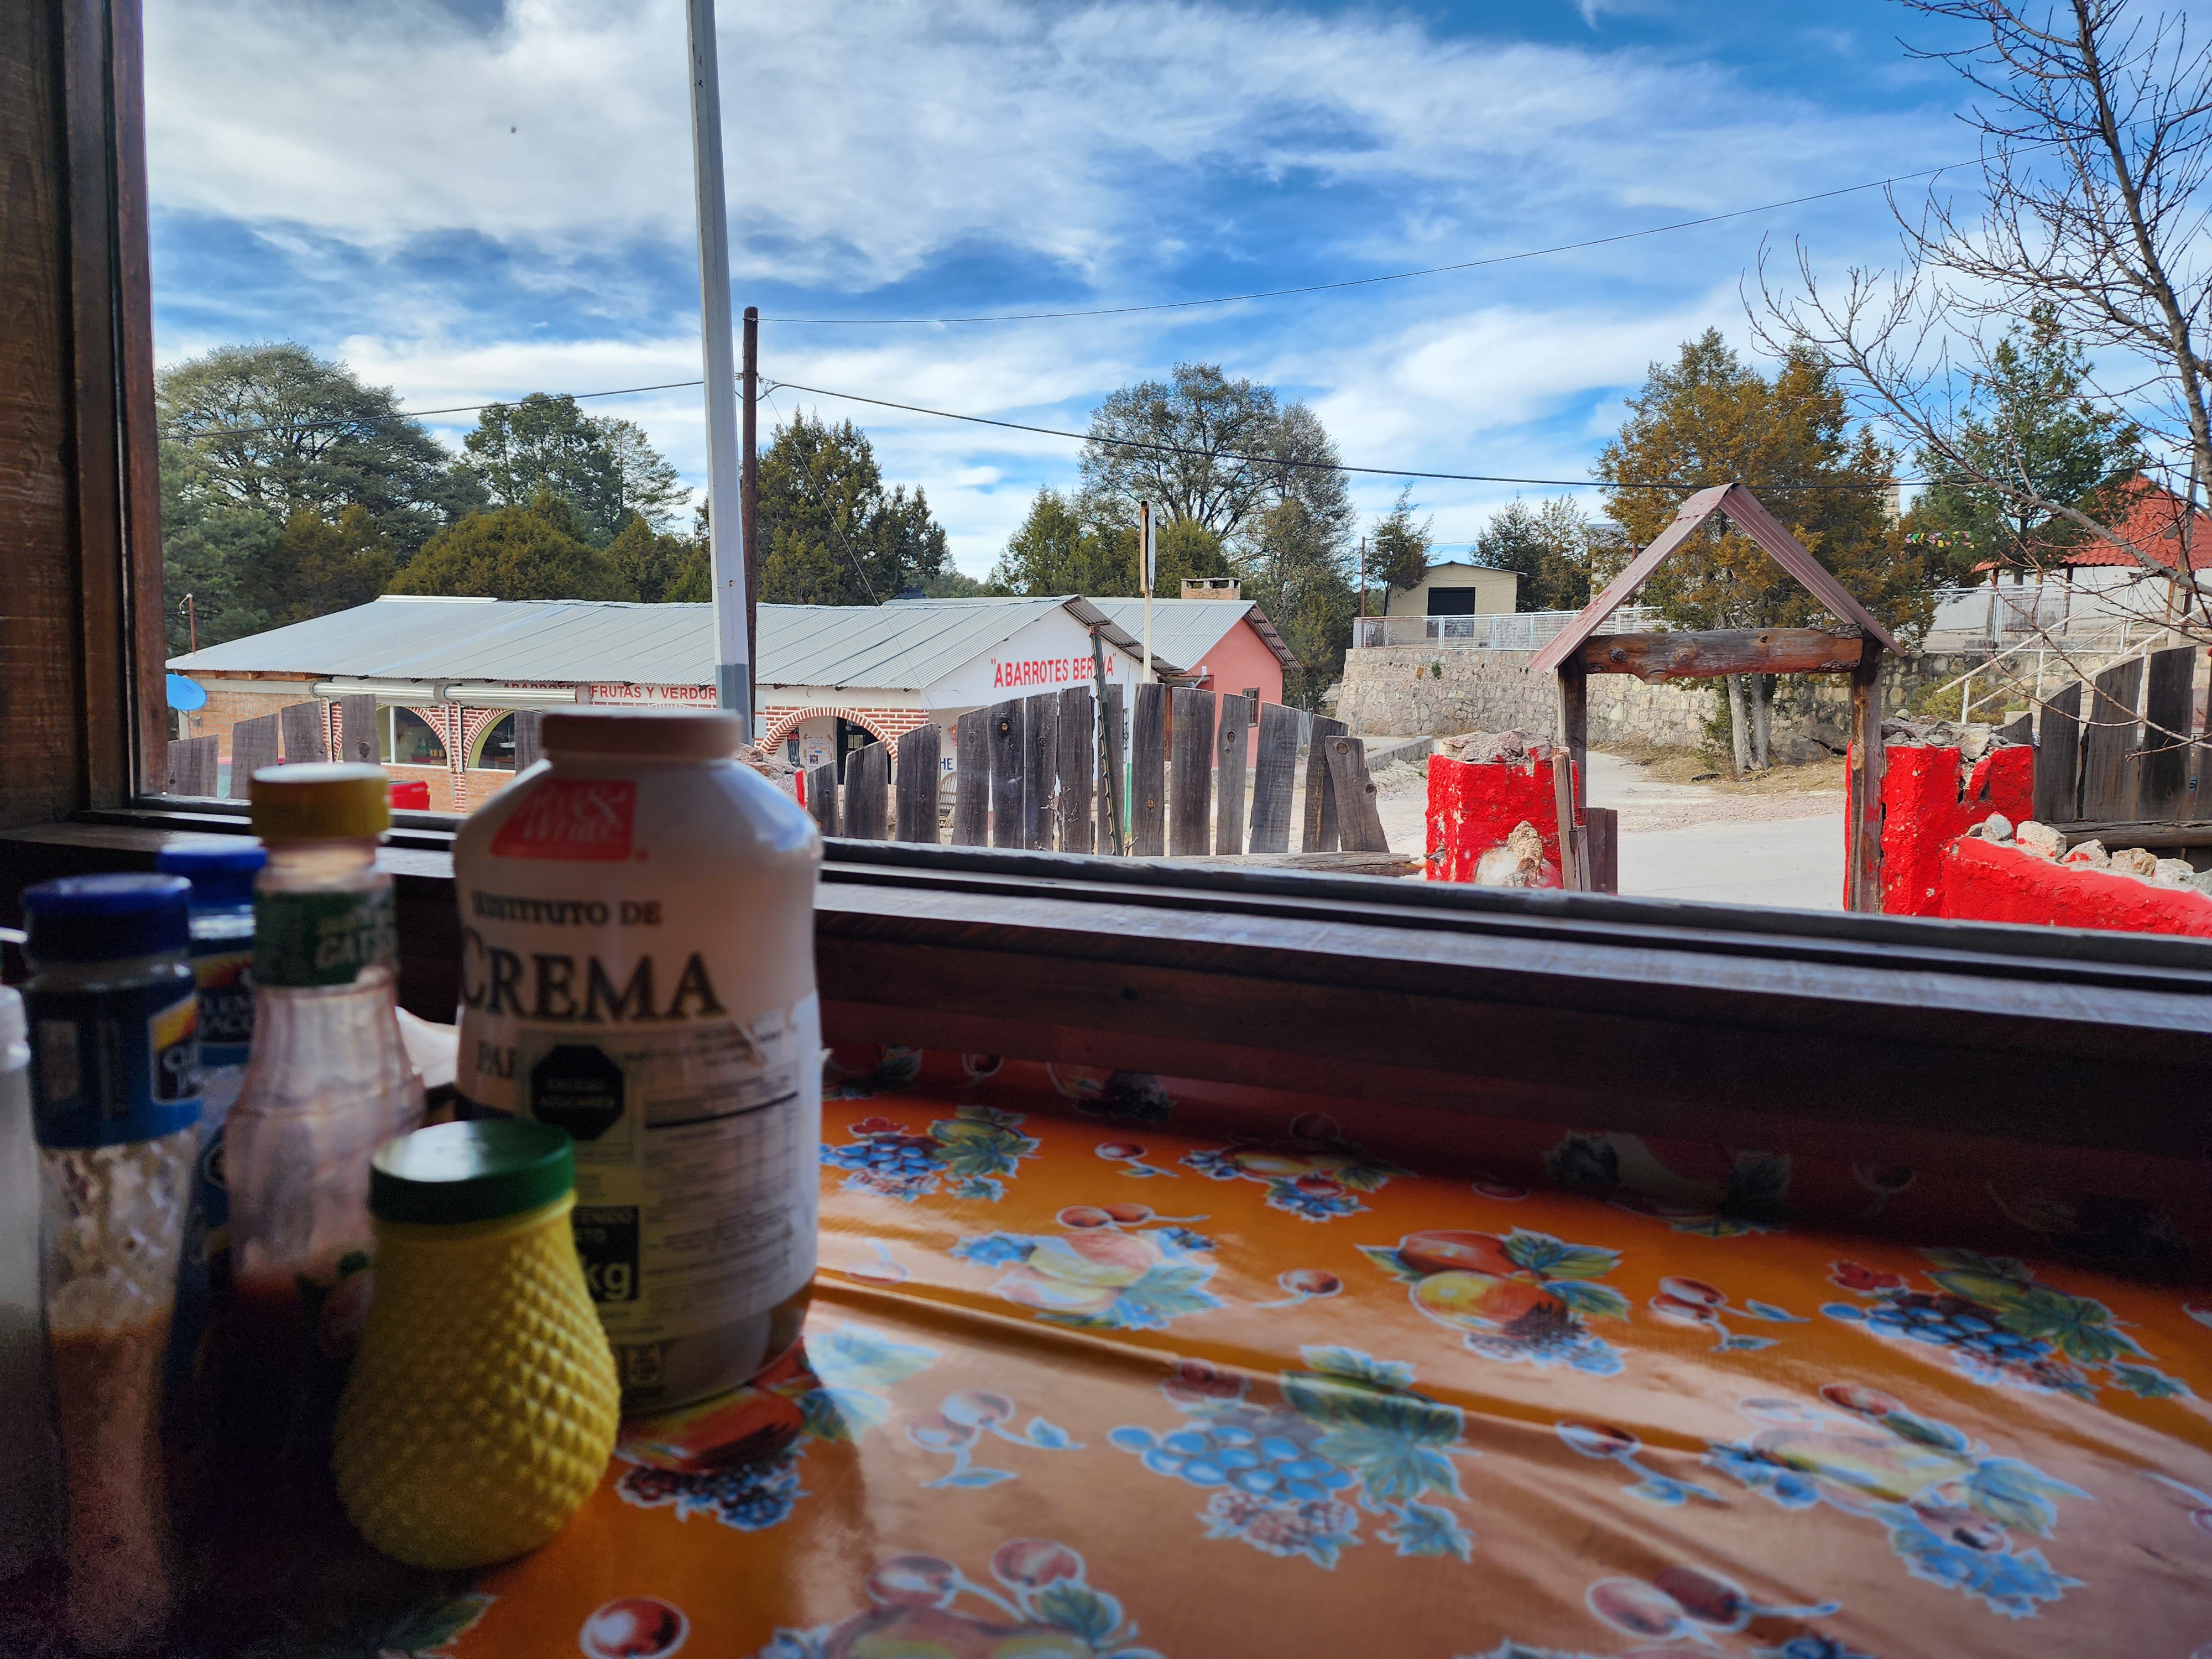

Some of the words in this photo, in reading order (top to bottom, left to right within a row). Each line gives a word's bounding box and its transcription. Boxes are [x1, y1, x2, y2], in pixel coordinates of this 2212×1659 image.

[591, 685, 641, 698] FRUTAS
[646, 686, 655, 698] Y
[619, 900, 662, 925] DE
[462, 926, 726, 1022] CREMA
